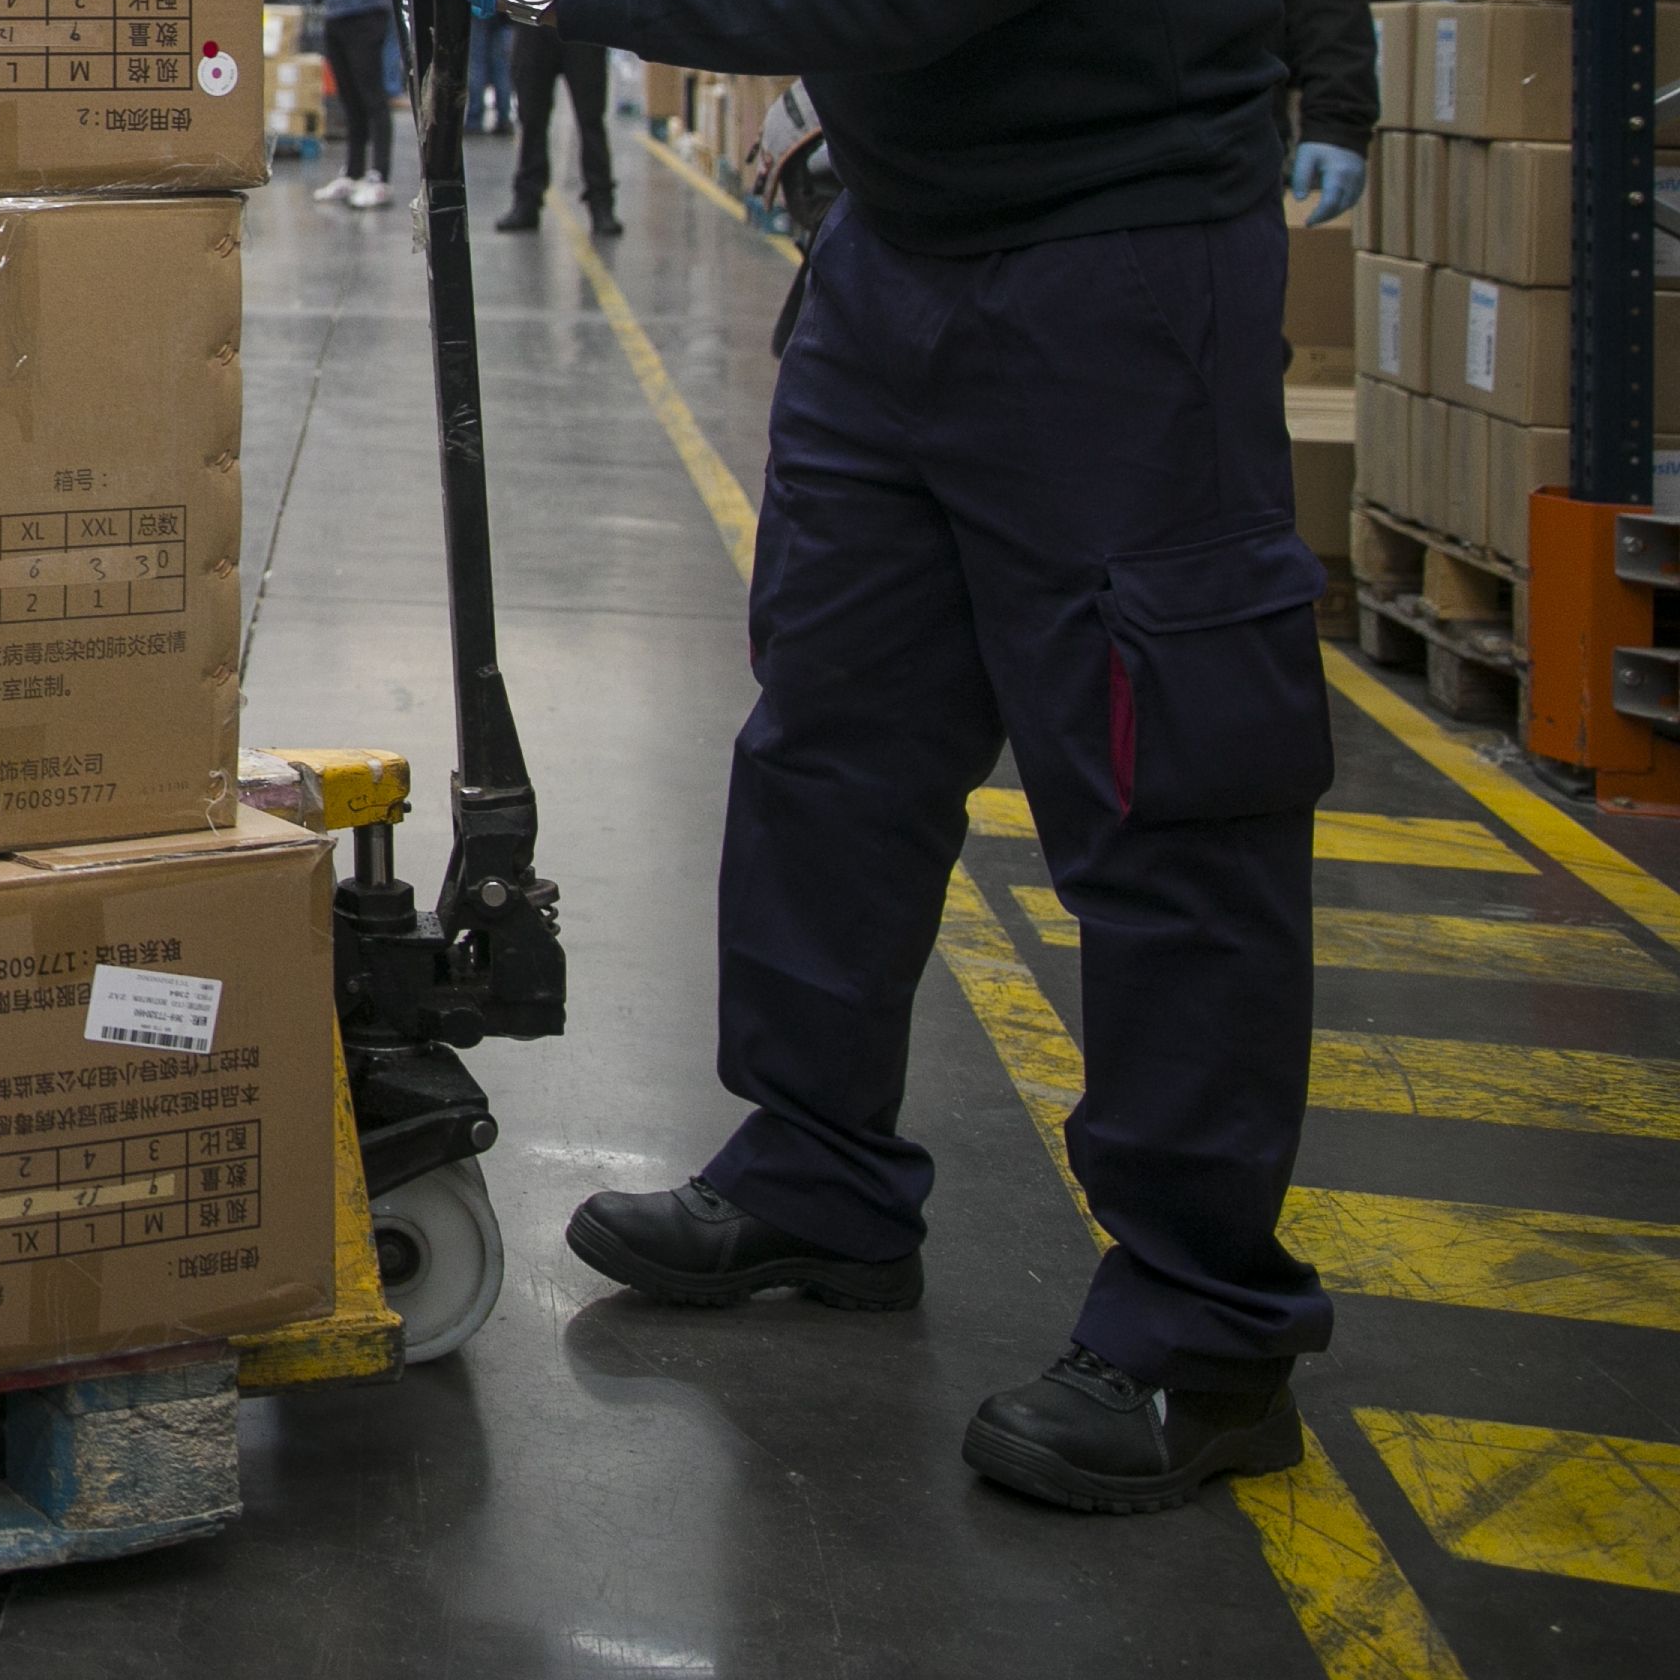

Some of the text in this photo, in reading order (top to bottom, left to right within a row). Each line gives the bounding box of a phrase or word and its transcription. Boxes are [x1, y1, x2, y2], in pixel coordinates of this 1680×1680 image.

[70, 23, 81, 41] 9
[7, 62, 18, 82] L
[70, 60, 89, 81] M
[75, 106, 89, 125] 2
